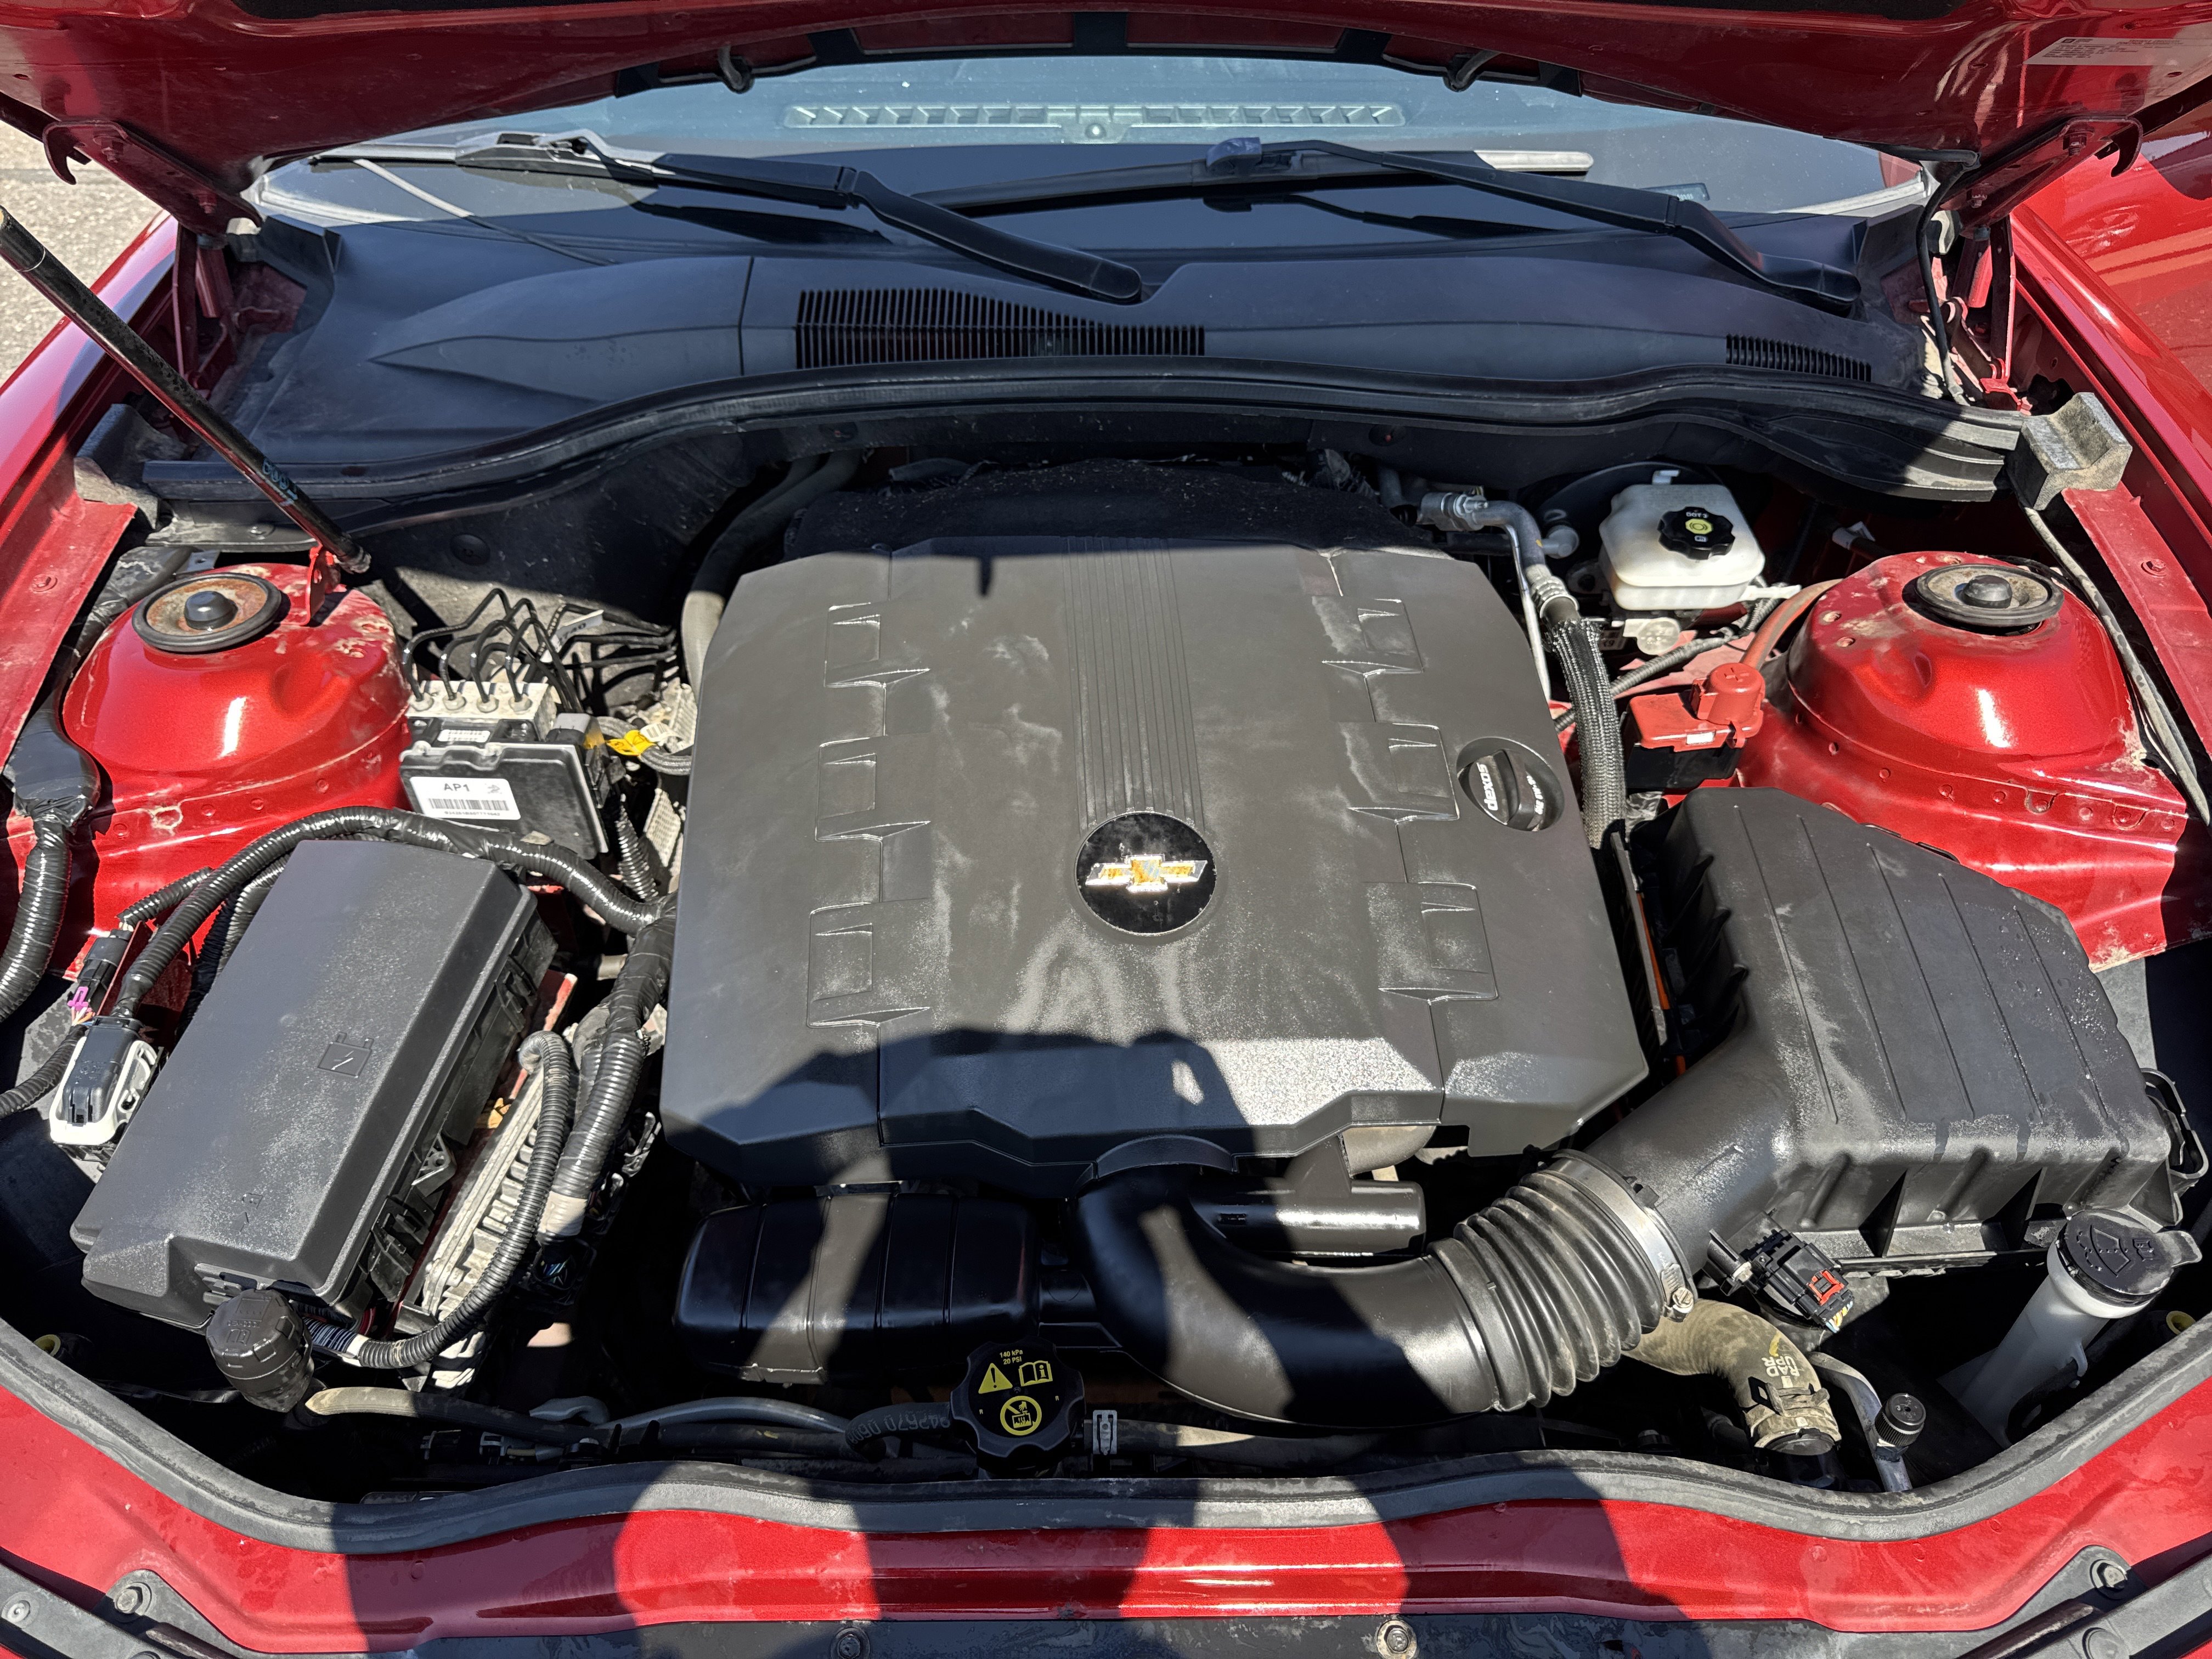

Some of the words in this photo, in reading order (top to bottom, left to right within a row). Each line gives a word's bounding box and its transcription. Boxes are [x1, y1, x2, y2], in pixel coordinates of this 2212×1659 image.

[444, 783, 470, 792] AP1
[1476, 762, 1498, 811] dexos
[1761, 1356, 1796, 1367] UPR
[1766, 1365, 1800, 1377] RAD
